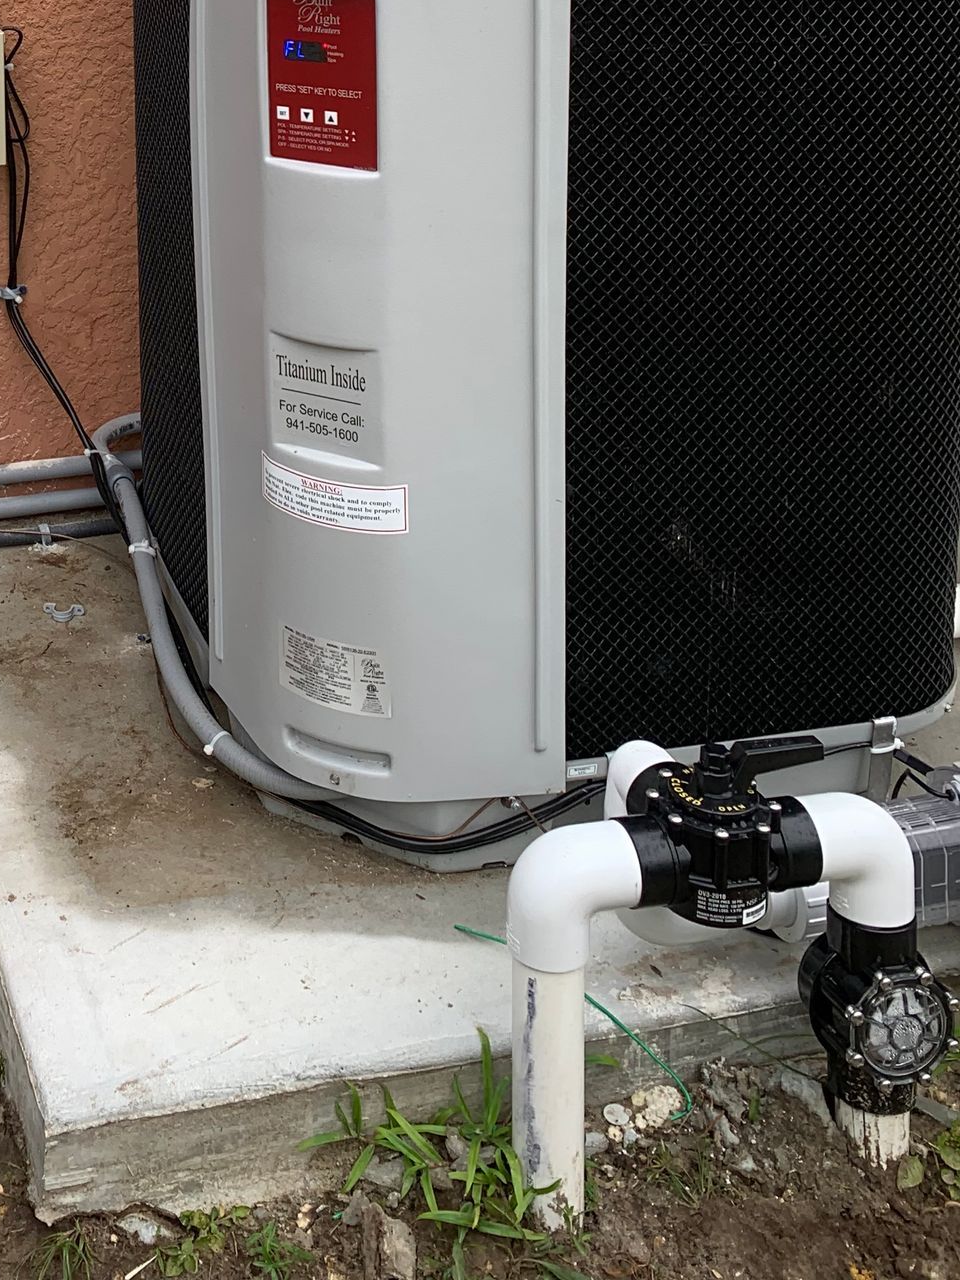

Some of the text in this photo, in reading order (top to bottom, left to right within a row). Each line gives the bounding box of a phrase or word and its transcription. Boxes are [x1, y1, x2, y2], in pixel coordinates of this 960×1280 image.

[298, 3, 340, 26] Right
[298, 24, 340, 35] Pool Heaters
[276, 83, 296, 92] PRESS
[328, 89, 337, 97] TO
[338, 90, 362, 99] SELECT
[289, 123, 321, 131] TEMPERATURE
[276, 354, 366, 392] Titanium Inside
[279, 400, 365, 428] For Service Call:
[286, 418, 358, 443] 941-505-1600
[285, 482, 299, 490] severe
[301, 487, 326, 499] electrical
[301, 479, 343, 495] WARNING:
[296, 500, 309, 508] other
[324, 509, 345, 517] related
[297, 508, 310, 516] voids
[320, 501, 345, 510] machine
[671, 778, 702, 806] CLOSED
